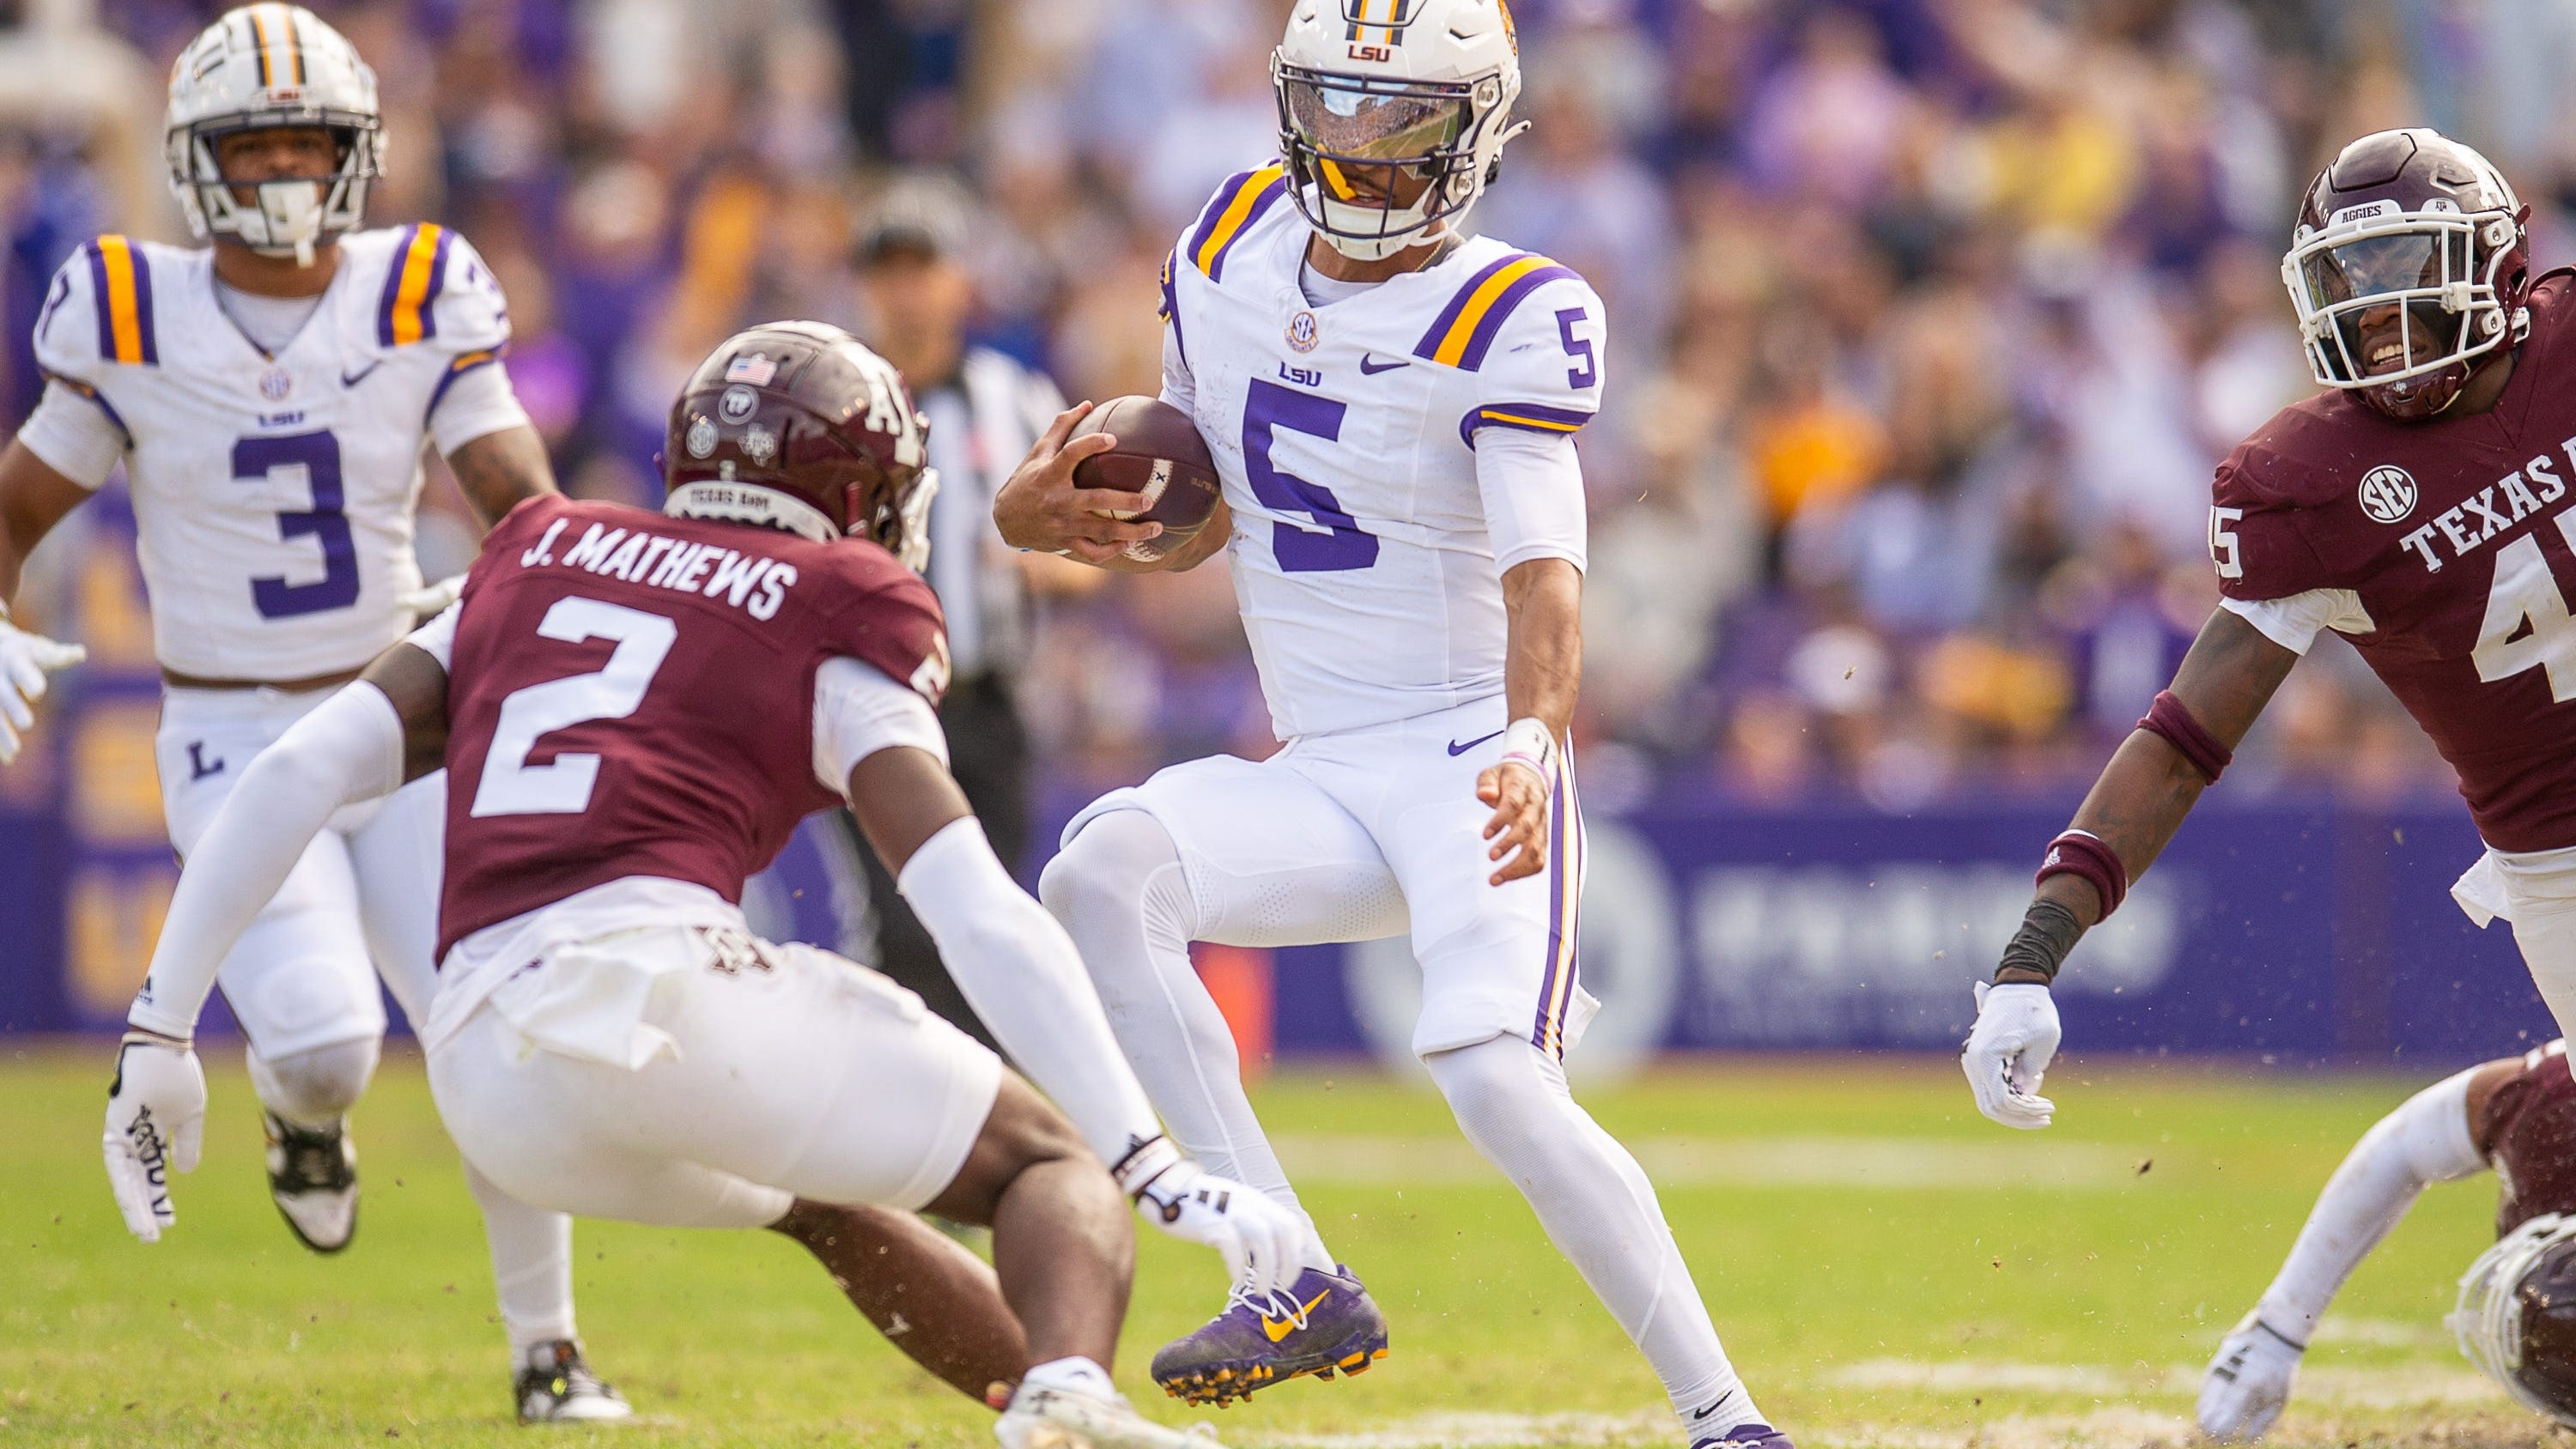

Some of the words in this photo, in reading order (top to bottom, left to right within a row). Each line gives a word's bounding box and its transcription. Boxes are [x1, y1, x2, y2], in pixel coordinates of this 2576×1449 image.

[1347, 45, 1390, 63] LSU
[2342, 205, 2382, 223] AGGIES
[1279, 361, 1322, 387] LSU
[1555, 306, 1595, 389] 5
[1242, 376, 1380, 573] 5
[2362, 469, 2414, 518] SEC
[2399, 454, 2566, 573] TEXAS
[231, 429, 361, 621] 3
[520, 517, 569, 567] J.
[562, 522, 799, 621] MATHEWS
[2470, 505, 2576, 704] 4
[471, 596, 678, 818] 2
[185, 740, 225, 781] L
